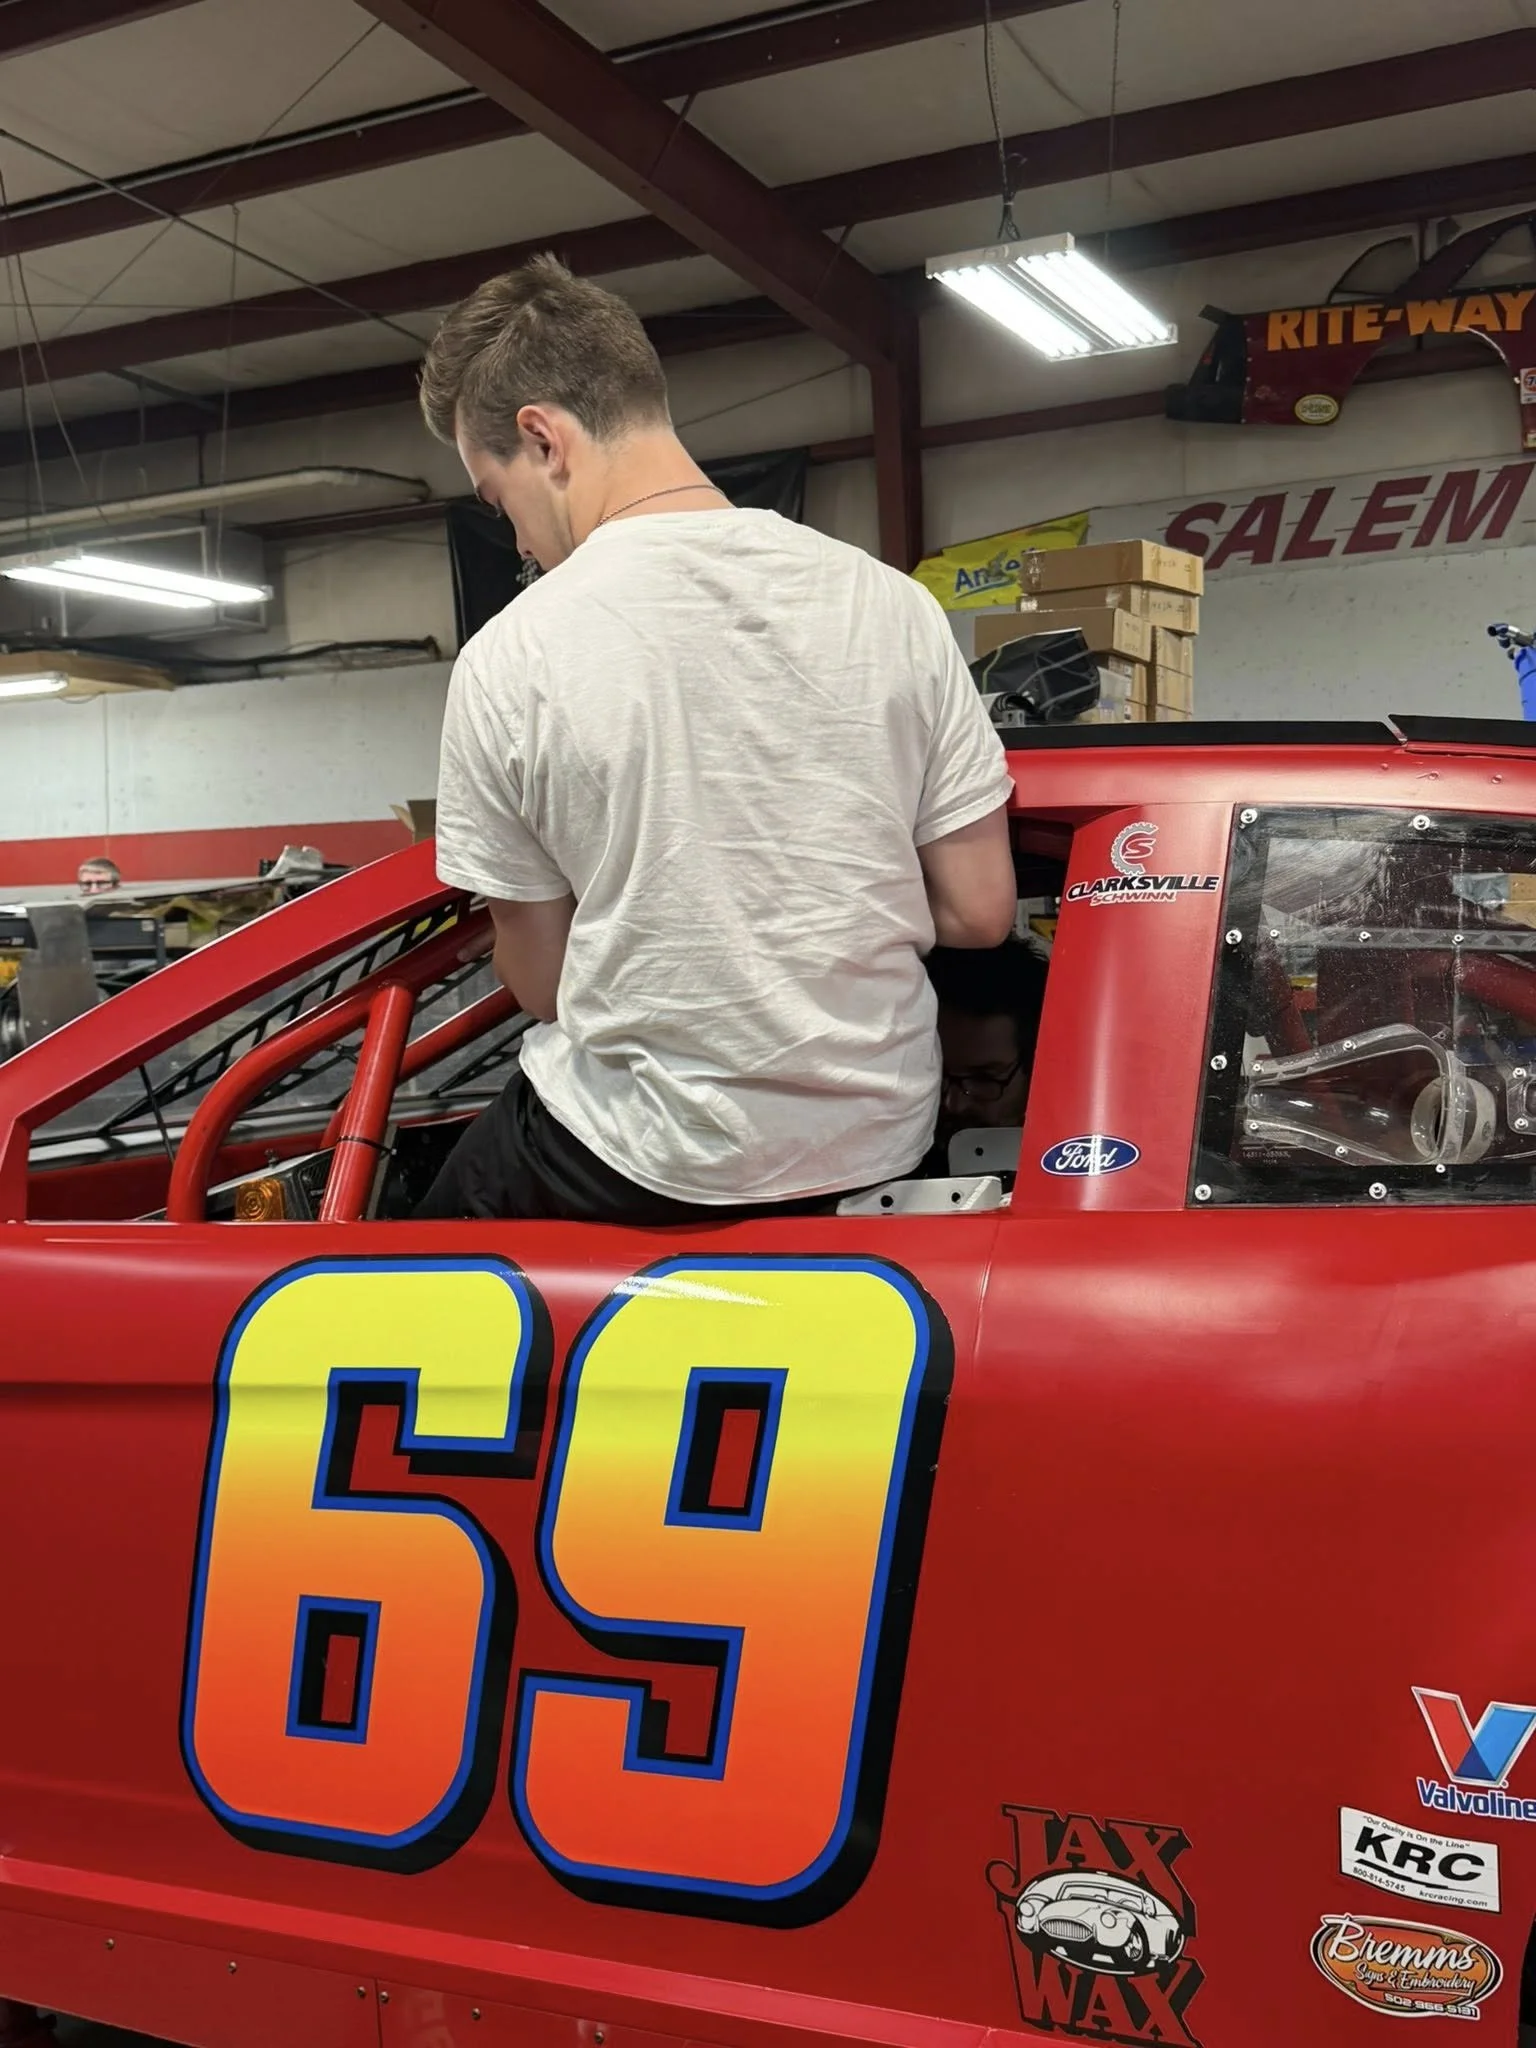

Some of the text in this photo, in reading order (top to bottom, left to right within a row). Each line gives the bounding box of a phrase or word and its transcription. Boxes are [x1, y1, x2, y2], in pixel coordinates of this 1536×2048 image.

[1267, 289, 1536, 352] RITE-WAY
[1164, 462, 1536, 571] SALEM
[1068, 876, 1220, 899] CLARKSVILLE
[1091, 891, 1175, 906] SCHWINN
[1055, 1141, 1118, 1170] Ford
[179, 1253, 956, 1930] 69
[1417, 1777, 1536, 1820] Valvoline
[1355, 1826, 1485, 1881] KRC
[1381, 1822, 1406, 1836] Quality
[1415, 1834, 1428, 1843] On
[1429, 1837, 1443, 1846] the
[985, 1803, 1197, 1937] JAX
[1353, 1866, 1488, 1907] 800-814-5745 krcracing.com
[1324, 1916, 1477, 1971] Bremms
[998, 1900, 1206, 2048] WAX
[1356, 1962, 1475, 1995] Signs & Embroidery
